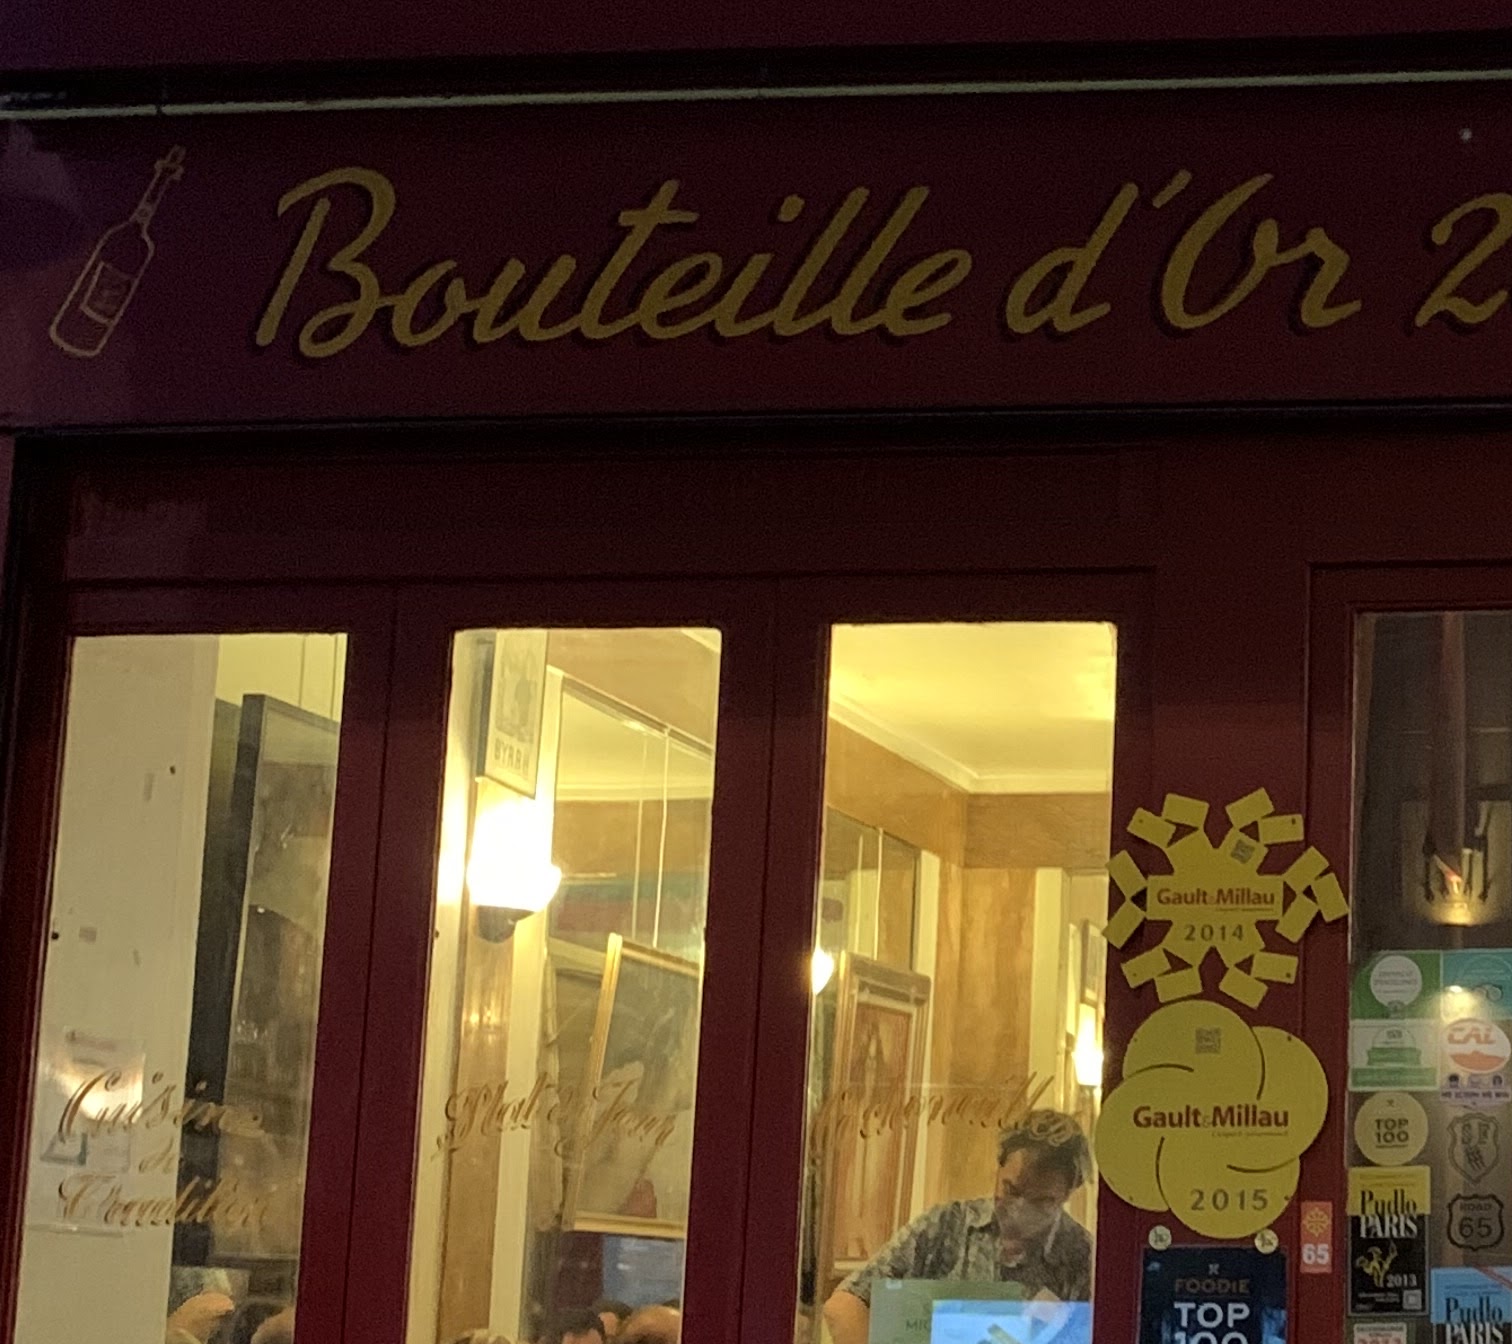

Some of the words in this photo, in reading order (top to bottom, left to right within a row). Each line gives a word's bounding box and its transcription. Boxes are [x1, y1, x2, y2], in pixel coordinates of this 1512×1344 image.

[255, 165, 972, 359] Bouteille
[1003, 168, 1362, 336] d'Or
[1184, 923, 1244, 942] 2014
[1374, 1118, 1409, 1132] TOP
[1374, 1130, 1409, 1144] 100
[1190, 1188, 1269, 1212] 2015
[1359, 1188, 1418, 1216] Pudlo
[1359, 1214, 1419, 1239] PARIS
[1458, 1217, 1493, 1239] 65
[1301, 1243, 1330, 1265] 65
[1173, 1277, 1250, 1295] FOODIE
[1173, 1301, 1250, 1329] TOP
[1444, 1296, 1503, 1323] Pudlo
